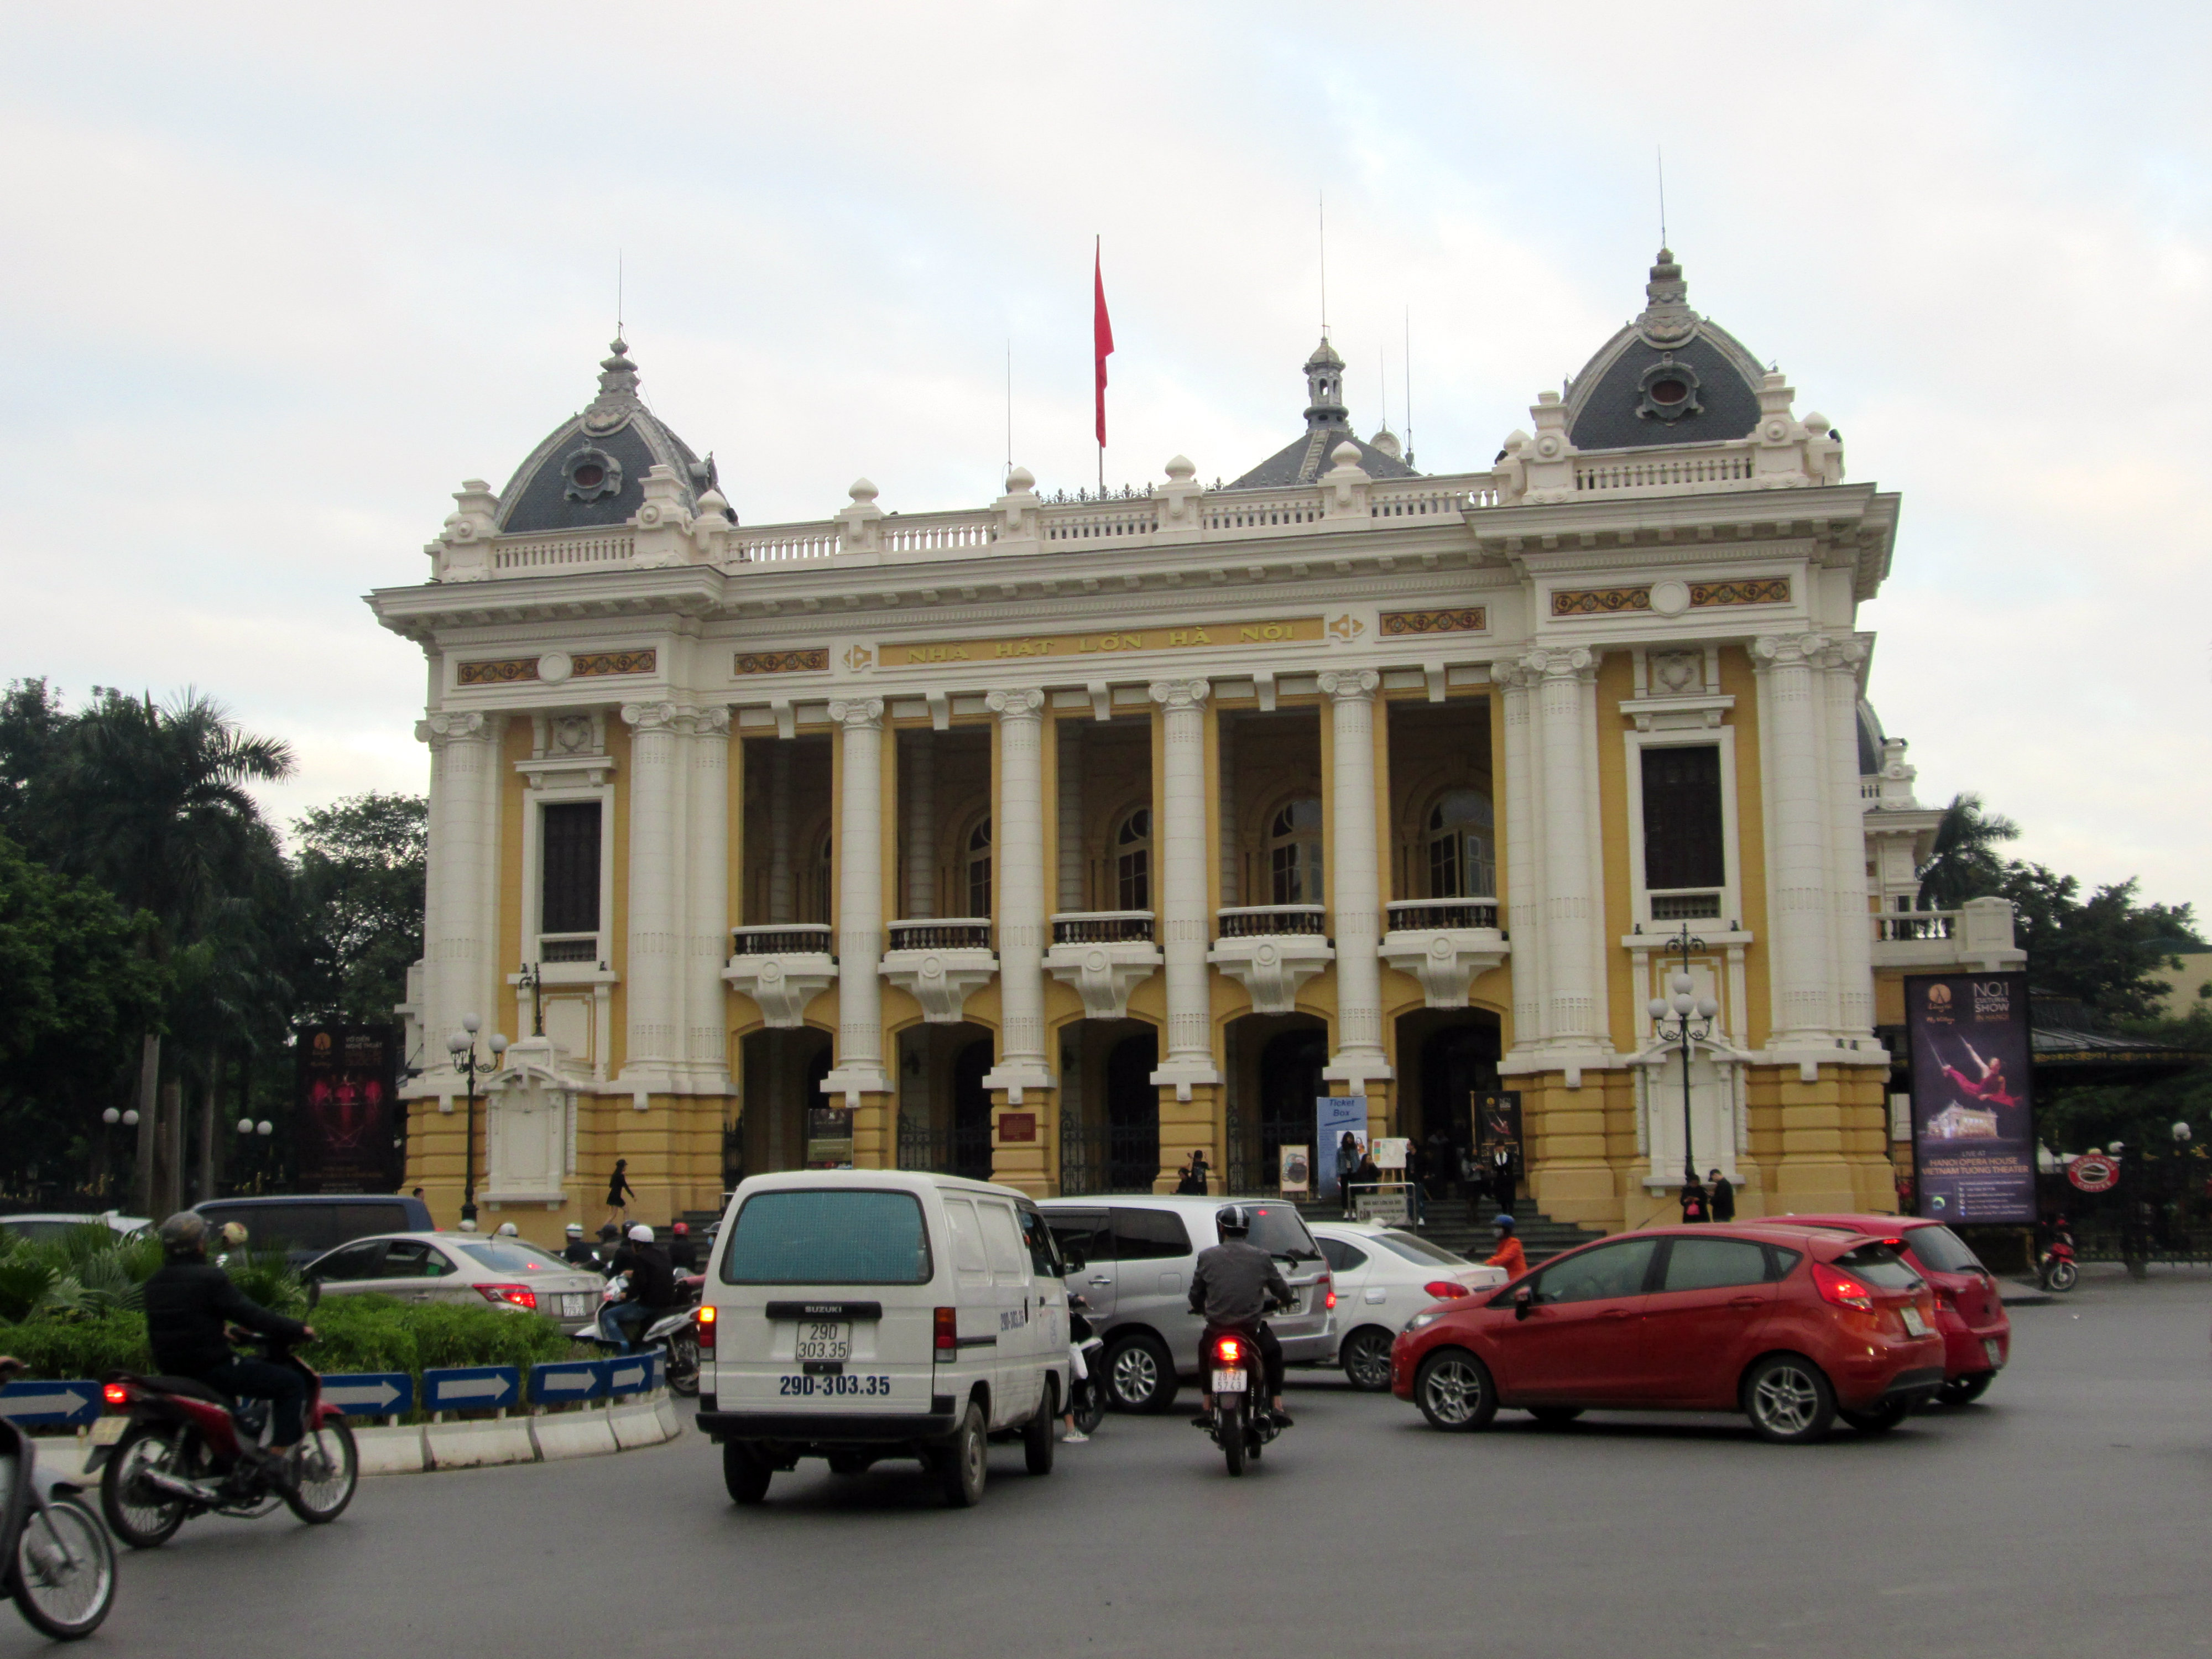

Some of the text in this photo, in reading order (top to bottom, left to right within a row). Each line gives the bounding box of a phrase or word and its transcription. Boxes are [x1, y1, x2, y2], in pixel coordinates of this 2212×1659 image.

[907, 622, 1295, 662] NHÀ HÁT LỚN HÀ NỘI
[1973, 982, 2008, 997] NO.1
[1975, 1003, 2010, 1013] SHOW
[1329, 1099, 1355, 1107] Ticket
[810, 1324, 838, 1340] 29D
[798, 1342, 847, 1358] 303.35
[780, 1375, 890, 1396] 29D-303.35
